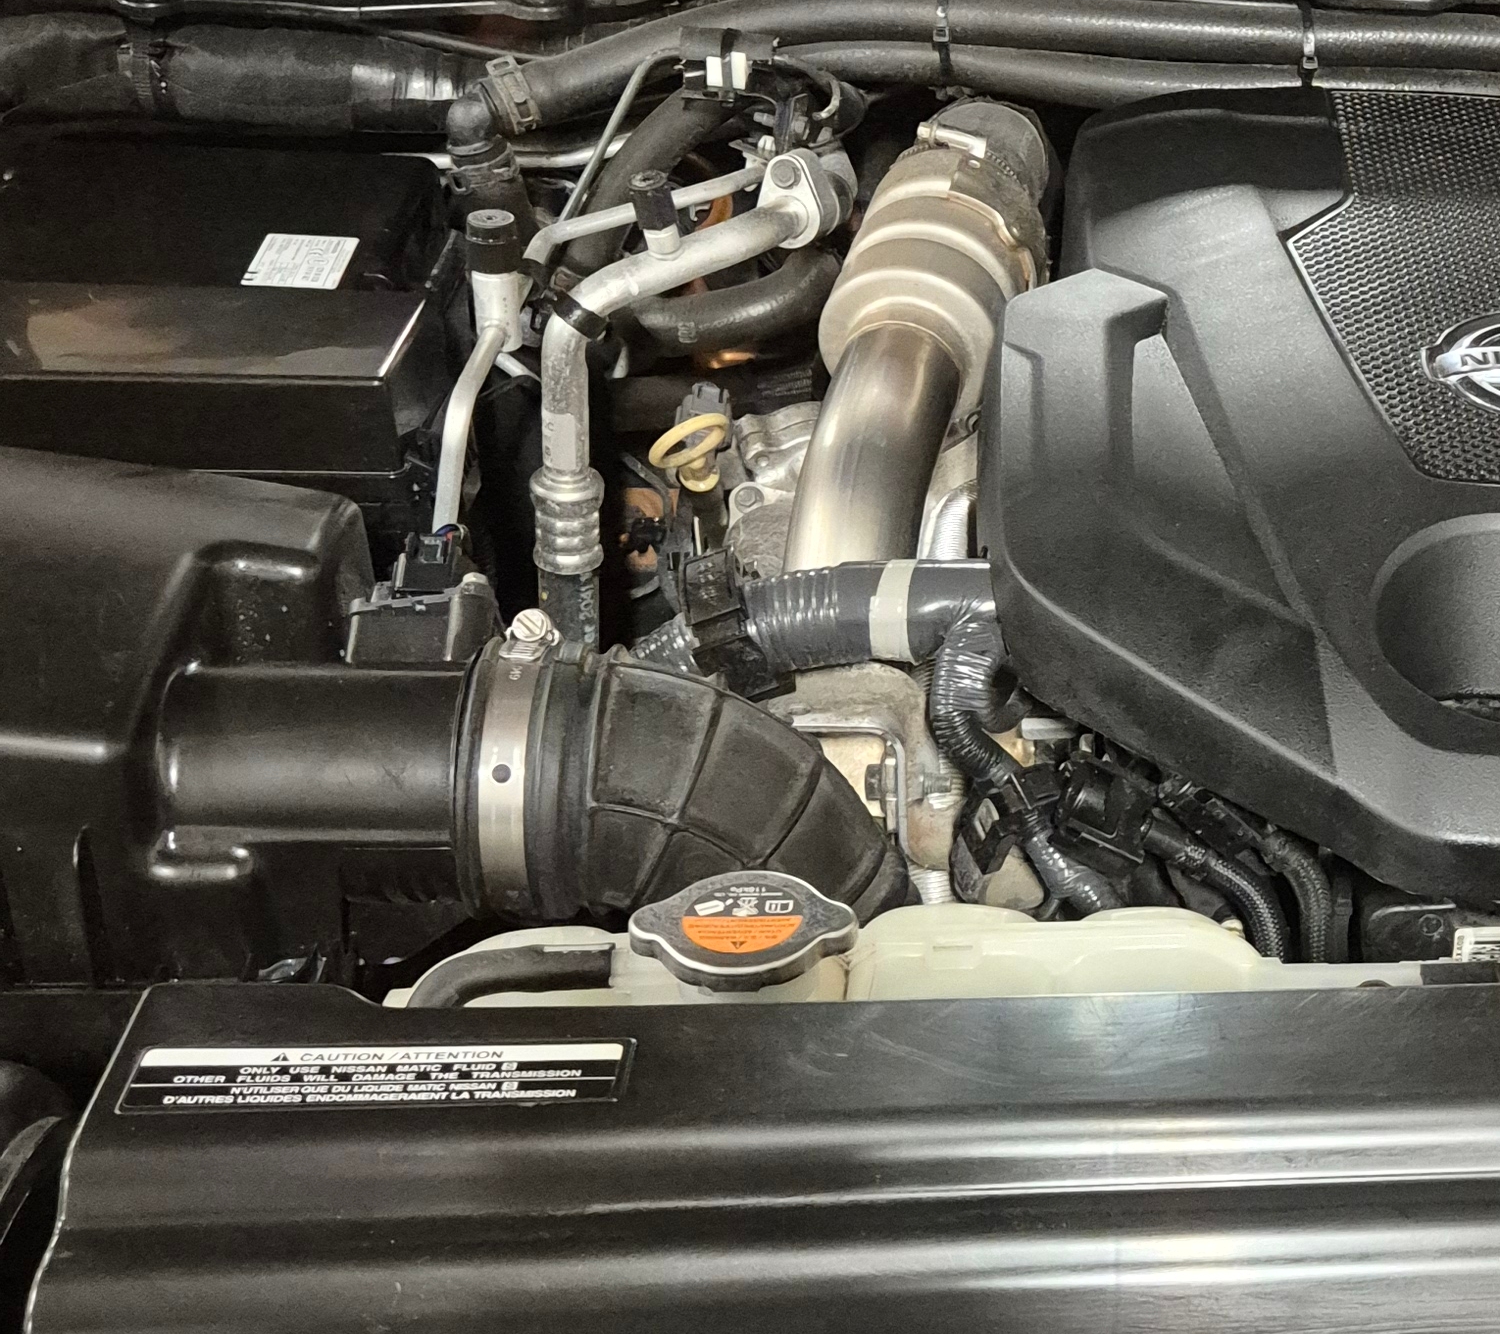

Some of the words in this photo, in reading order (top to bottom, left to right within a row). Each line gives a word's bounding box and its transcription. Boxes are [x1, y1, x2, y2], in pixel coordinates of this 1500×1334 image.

[300, 1052, 385, 1062] CAUTION
[239, 1066, 282, 1075] ONLY
[288, 1066, 321, 1074] USE
[330, 1065, 388, 1074] NISSAN
[395, 1064, 442, 1073] MATIC
[452, 1063, 497, 1072] FLUID
[172, 1075, 226, 1084] OTHER
[235, 1074, 291, 1083] FLUIDS
[302, 1074, 339, 1082] WILL
[351, 1072, 418, 1082] DAMAGE
[429, 1071, 460, 1080] THE
[471, 1069, 582, 1079] TRANSMISSION
[229, 1085, 300, 1095] N'UTILISER
[300, 1085, 330, 1094] QUE
[331, 1084, 352, 1093] DU
[352, 1083, 405, 1093] LIQUIDE
[406, 1083, 447, 1092] MATIC
[448, 1082, 498, 1091] NISSAN
[162, 1094, 235, 1105] D'AUTRES
[236, 1094, 303, 1104] LIQUIDES
[305, 1091, 449, 1103] ENDOMMAGERAIENT
[449, 1090, 471, 1100] LA
[472, 1089, 577, 1099] TRANSMISSION
